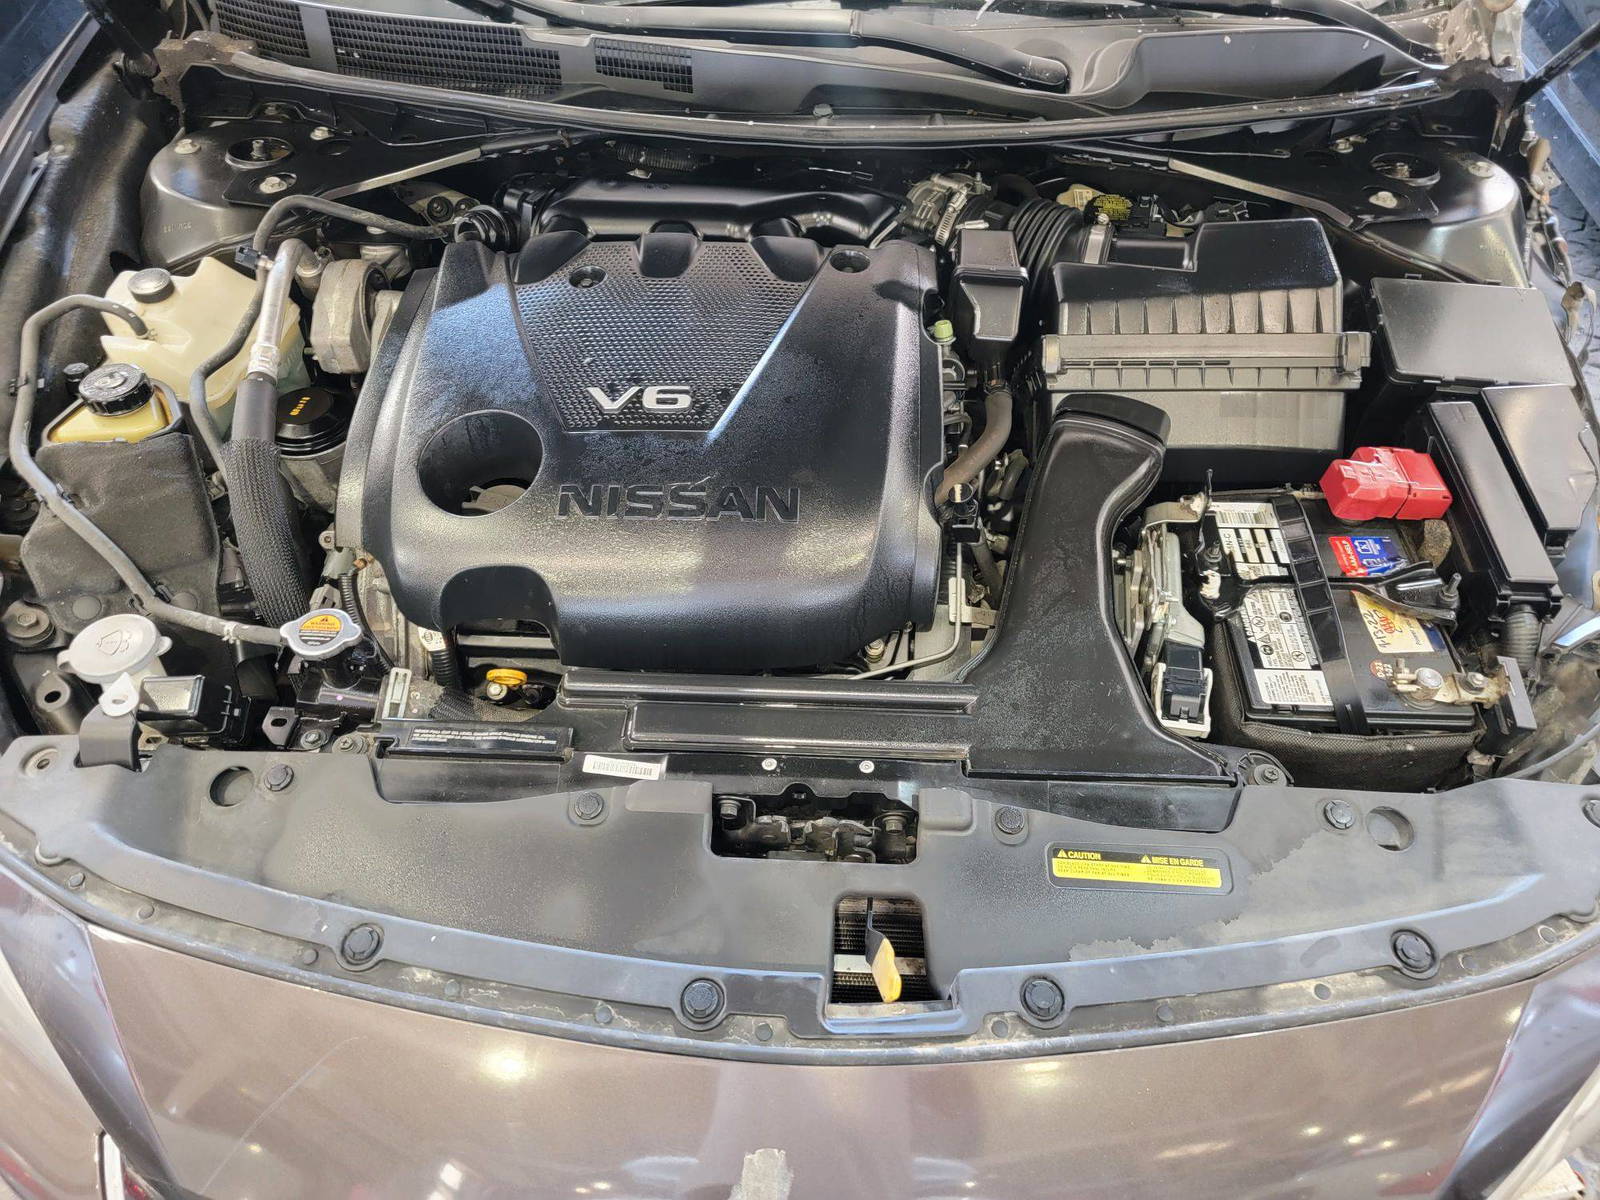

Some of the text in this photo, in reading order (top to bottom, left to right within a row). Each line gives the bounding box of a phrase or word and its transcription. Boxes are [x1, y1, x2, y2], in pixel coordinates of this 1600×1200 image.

[586, 386, 693, 413] V6
[556, 484, 801, 523] NISSAN
[1067, 850, 1101, 861] CAUTION
[1151, 856, 1204, 868] MISE EN GARDE
